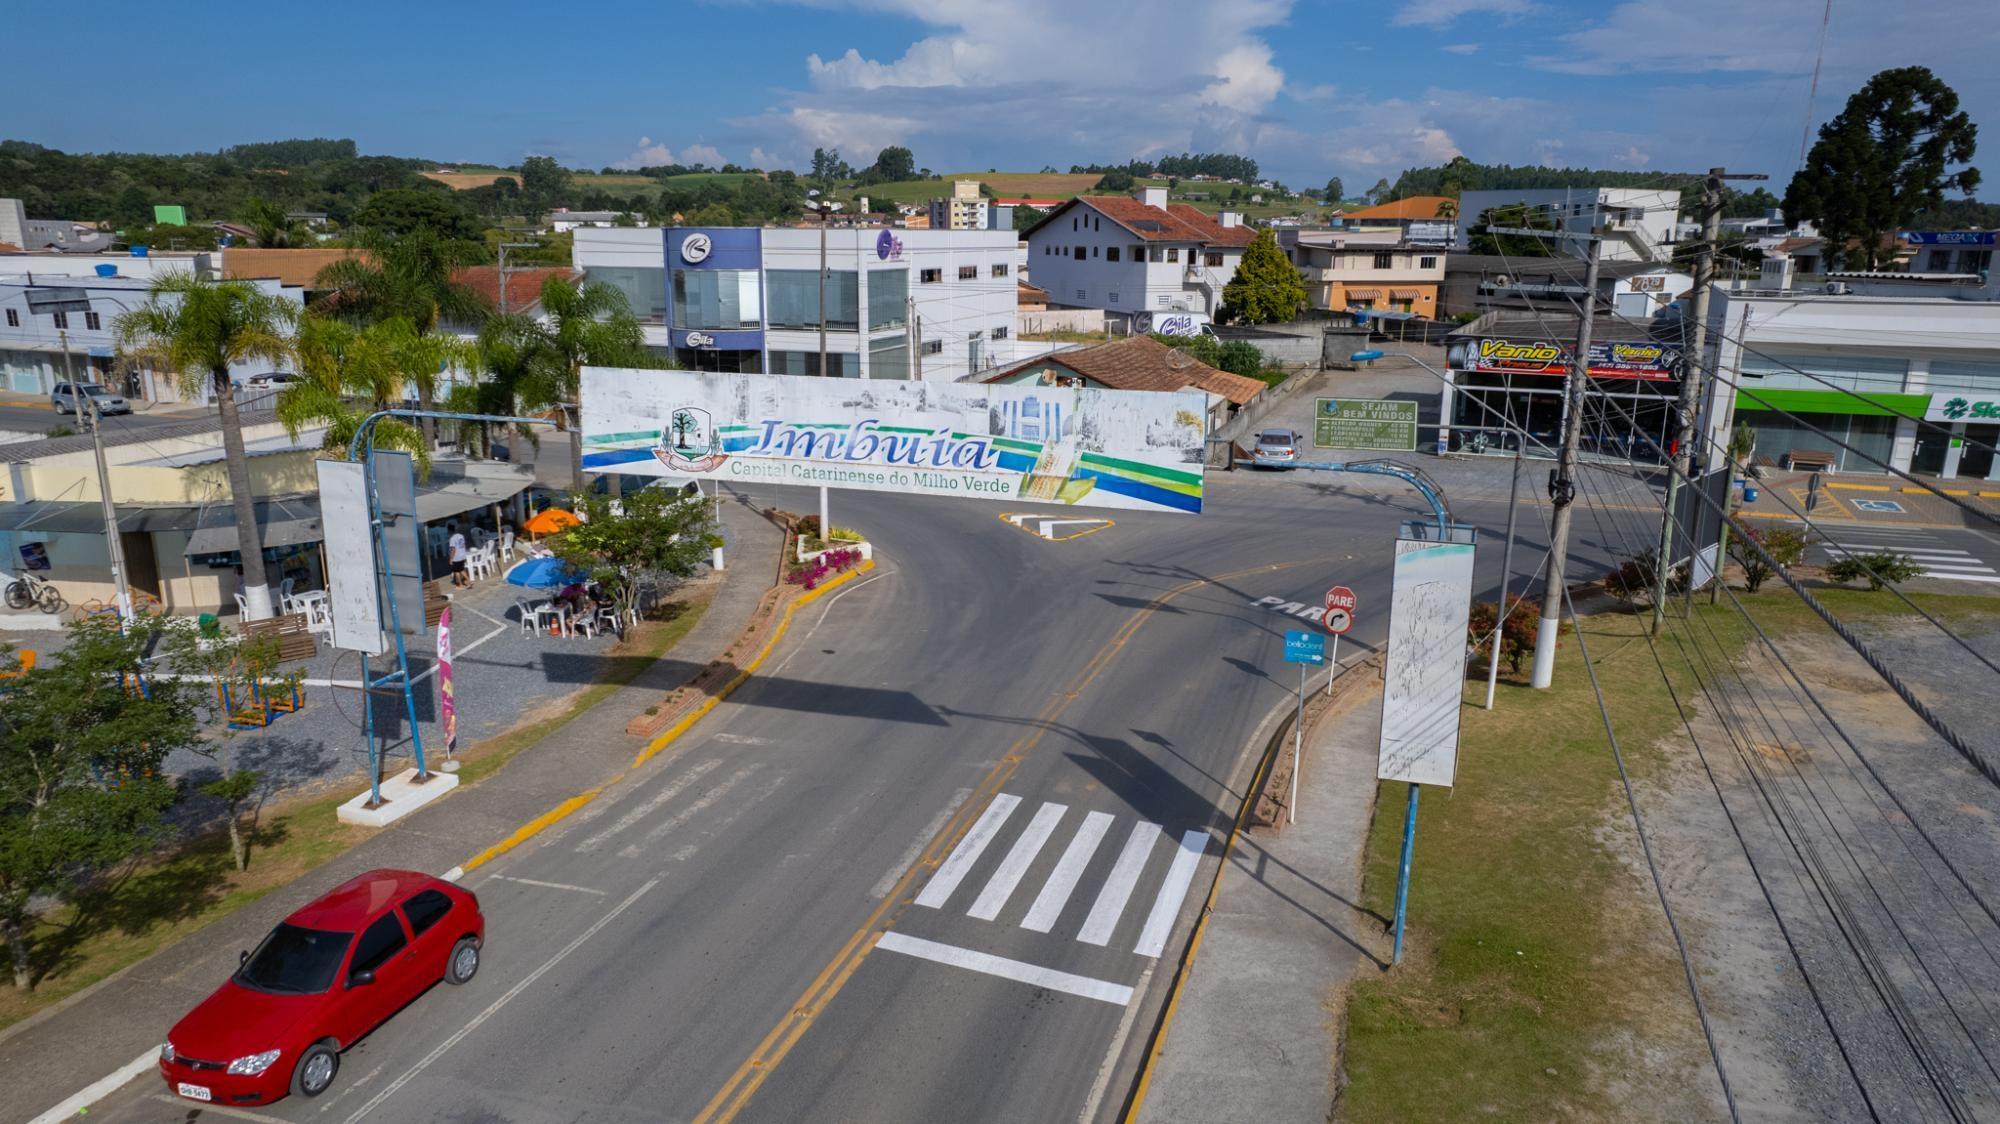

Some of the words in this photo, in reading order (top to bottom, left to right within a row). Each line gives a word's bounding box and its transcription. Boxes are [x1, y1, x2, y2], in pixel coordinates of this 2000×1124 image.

[1481, 341, 1559, 360] Vanio
[1343, 410, 1367, 418] BEM
[1371, 411, 1413, 420] VINDOS
[1361, 402, 1398, 411] SEJAM
[751, 418, 992, 470] Imbuia
[731, 462, 786, 478] Capital
[791, 464, 884, 484] Catarinense
[889, 472, 908, 486] do
[913, 473, 958, 489] Milho
[963, 476, 1010, 493] Verde
[1250, 595, 1326, 620] PAR
[1328, 594, 1353, 608] PARE
